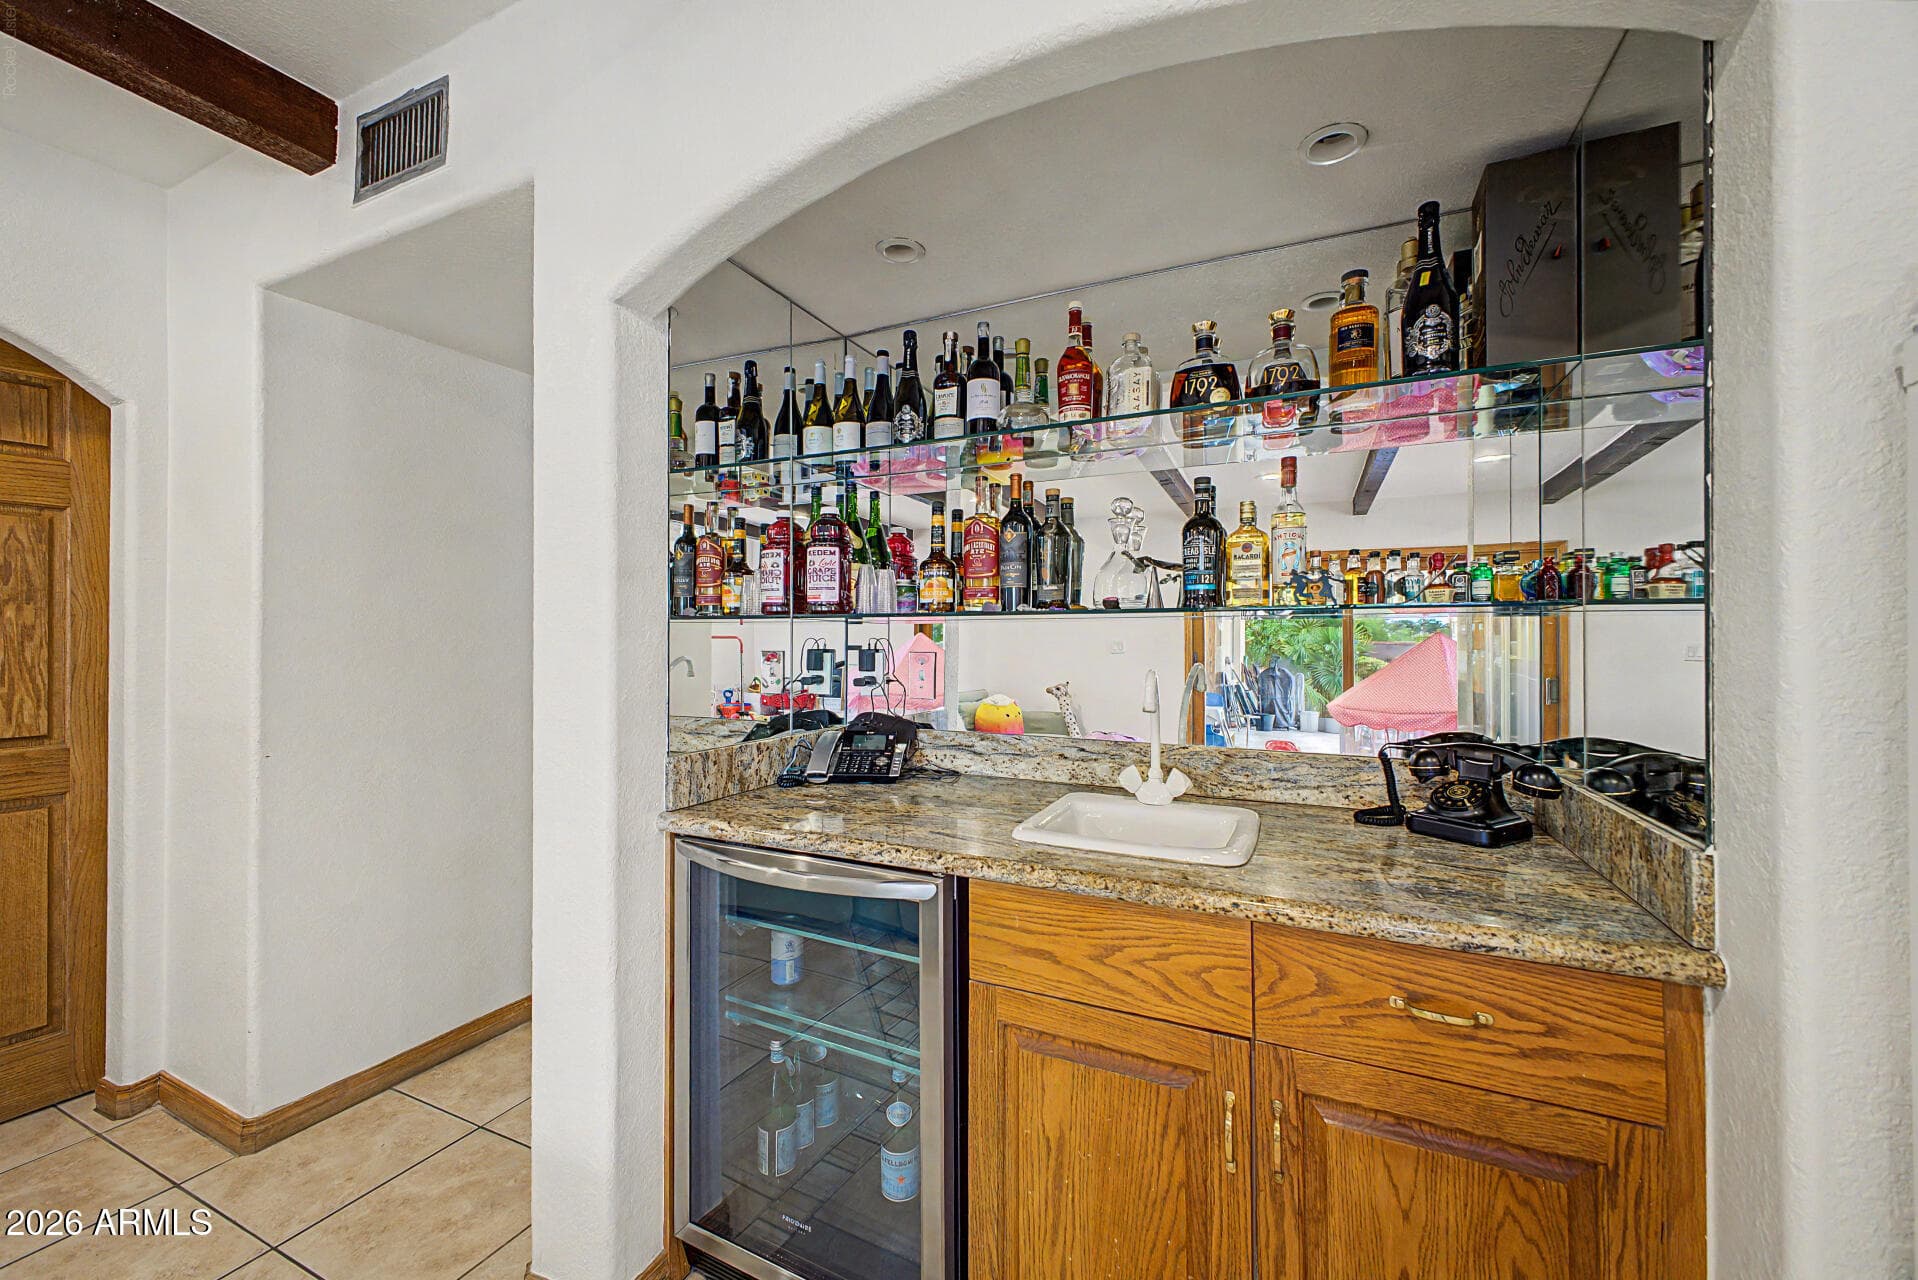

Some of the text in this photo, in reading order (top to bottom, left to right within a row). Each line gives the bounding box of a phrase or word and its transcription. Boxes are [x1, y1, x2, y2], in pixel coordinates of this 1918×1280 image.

[1264, 365, 1299, 386] 1792
[1184, 376, 1218, 397] 1792
[808, 567, 837, 575] GRAPE
[808, 574, 837, 583] JUICE
